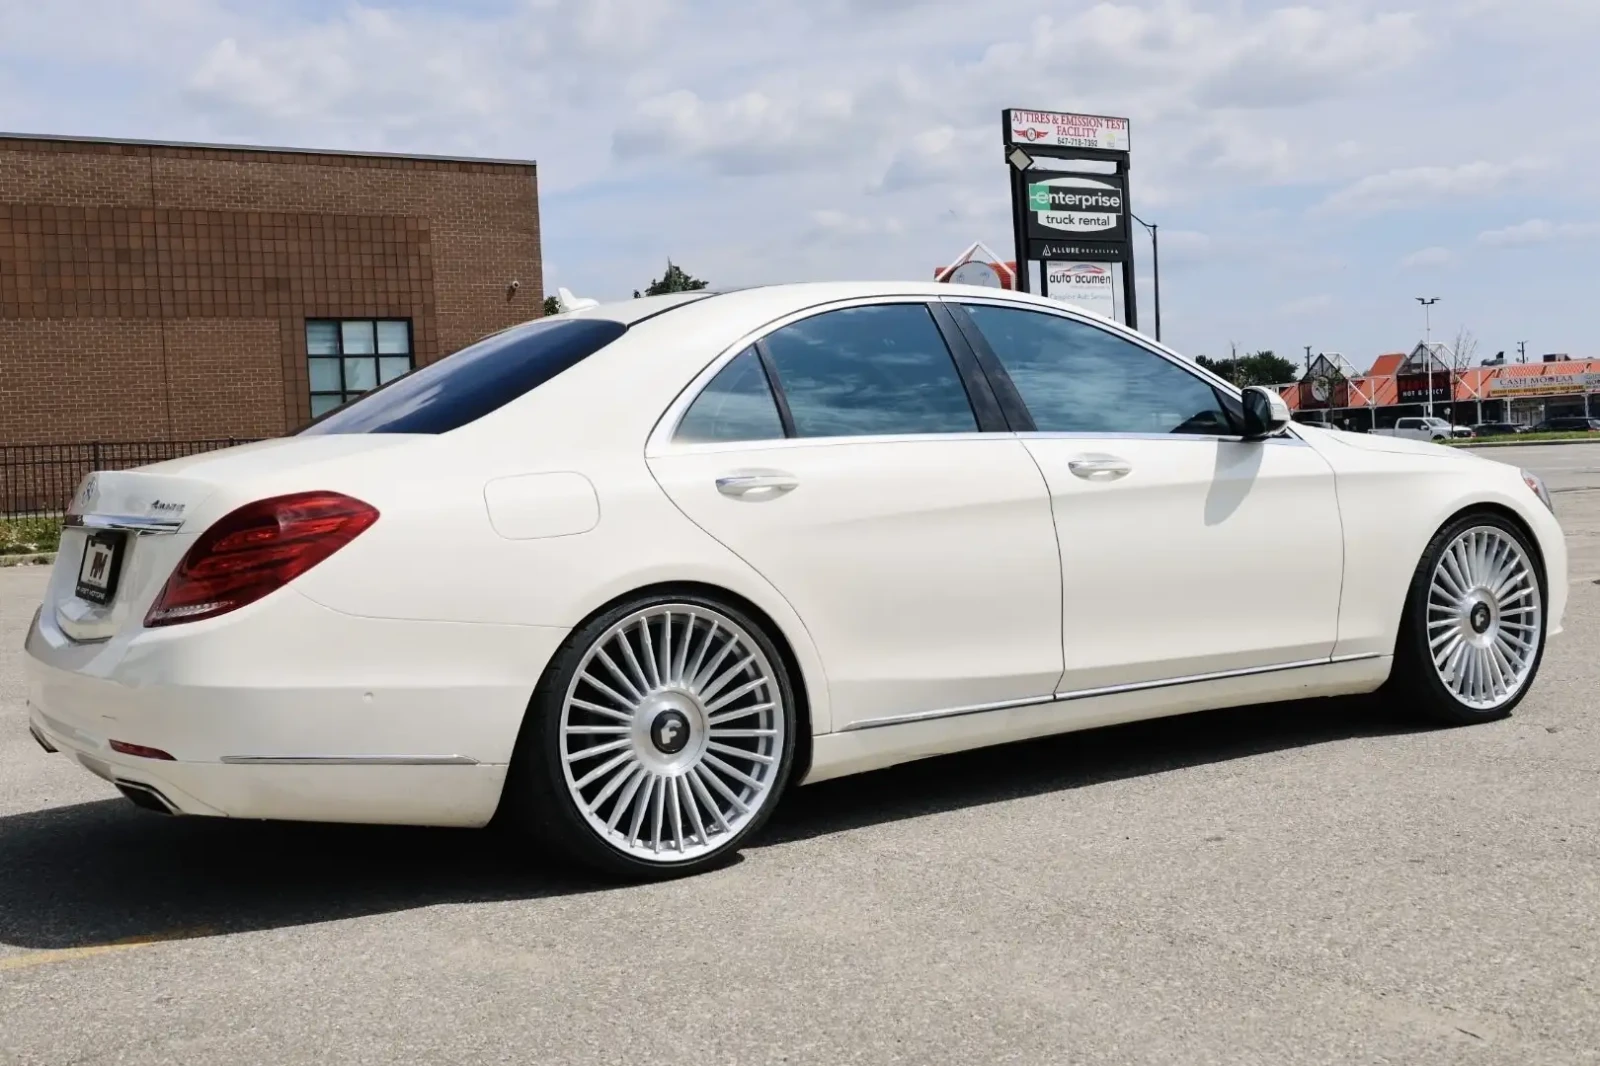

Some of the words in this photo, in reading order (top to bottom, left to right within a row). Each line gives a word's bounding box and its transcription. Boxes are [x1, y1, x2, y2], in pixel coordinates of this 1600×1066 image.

[1013, 112, 1022, 124] AJ
[1024, 112, 1051, 124] TIRES
[1052, 116, 1059, 125] &
[1061, 116, 1104, 128] EMISSION
[1105, 118, 1127, 130] TEST
[1056, 125, 1098, 138] FACILITY
[1035, 191, 1121, 209] enterprise
[1046, 214, 1075, 225] truck
[1079, 215, 1110, 226] rental
[1050, 272, 1072, 284] auto
[1075, 275, 1111, 284] acumen
[1500, 378, 1527, 386] CASH
[1425, 388, 1444, 396] SICY
